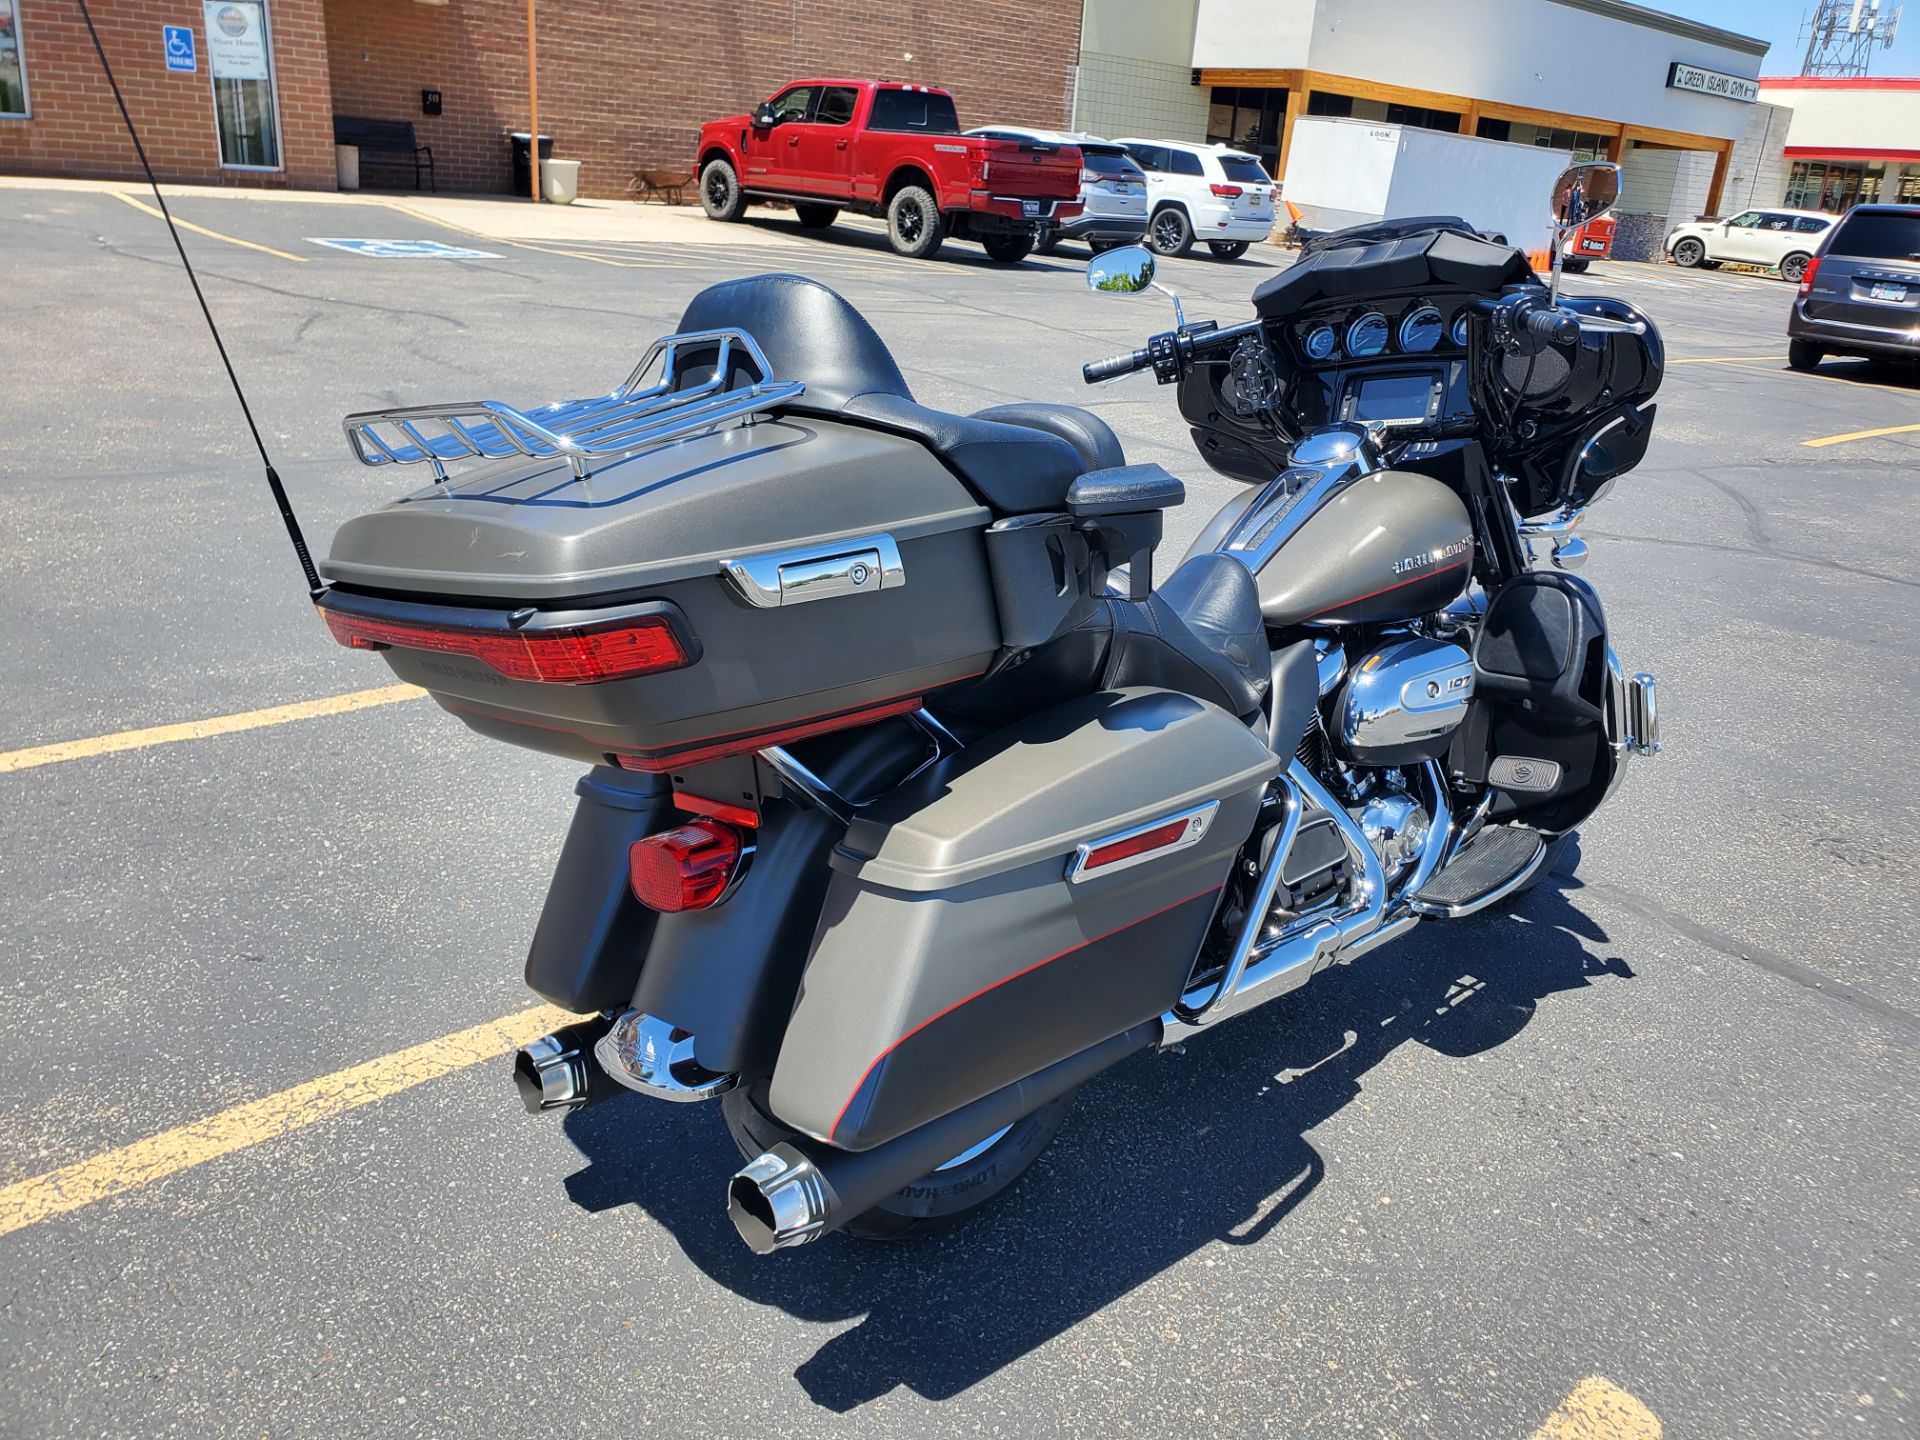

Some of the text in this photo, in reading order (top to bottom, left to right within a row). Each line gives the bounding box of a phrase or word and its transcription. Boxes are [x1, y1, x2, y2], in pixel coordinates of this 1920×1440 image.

[1684, 70, 1745, 98] GREEN ISLAND GYM
[1590, 241, 1606, 251] Bobcat
[1447, 675, 1471, 690] 107
